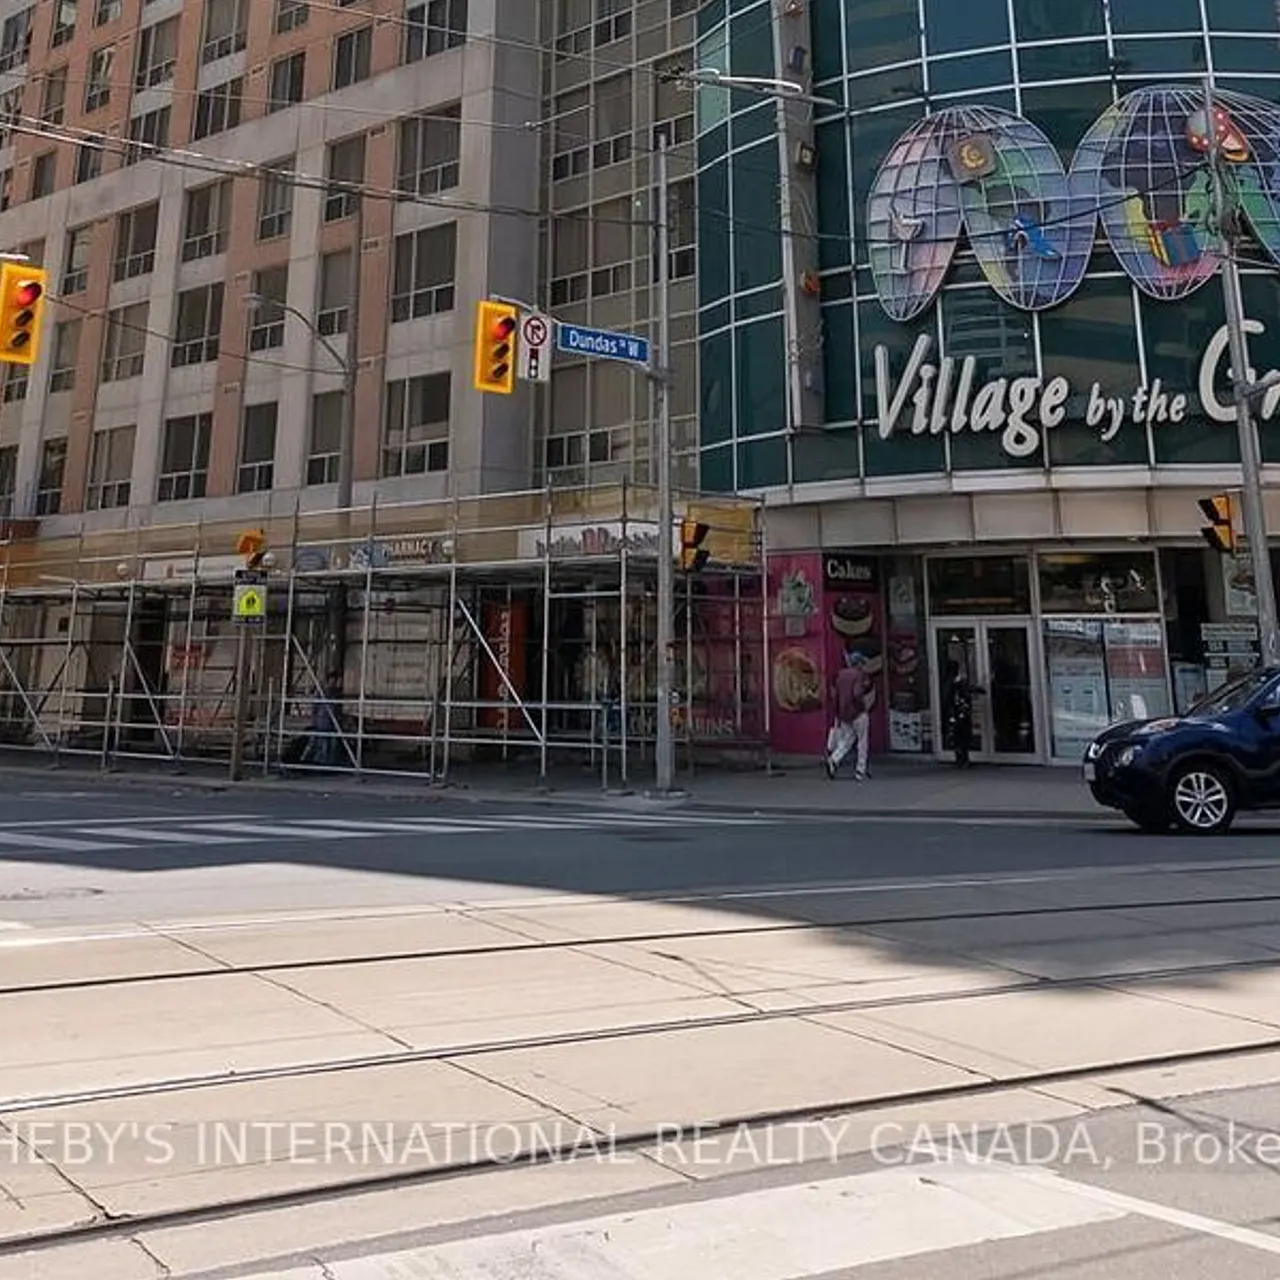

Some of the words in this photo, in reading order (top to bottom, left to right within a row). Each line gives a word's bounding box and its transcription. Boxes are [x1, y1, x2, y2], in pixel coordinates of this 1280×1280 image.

[569, 331, 617, 353] Dundas
[628, 343, 640, 357] W
[875, 333, 1069, 457] Village
[1085, 381, 1124, 441] by
[1132, 378, 1187, 422] the
[827, 559, 871, 580] Cakes
